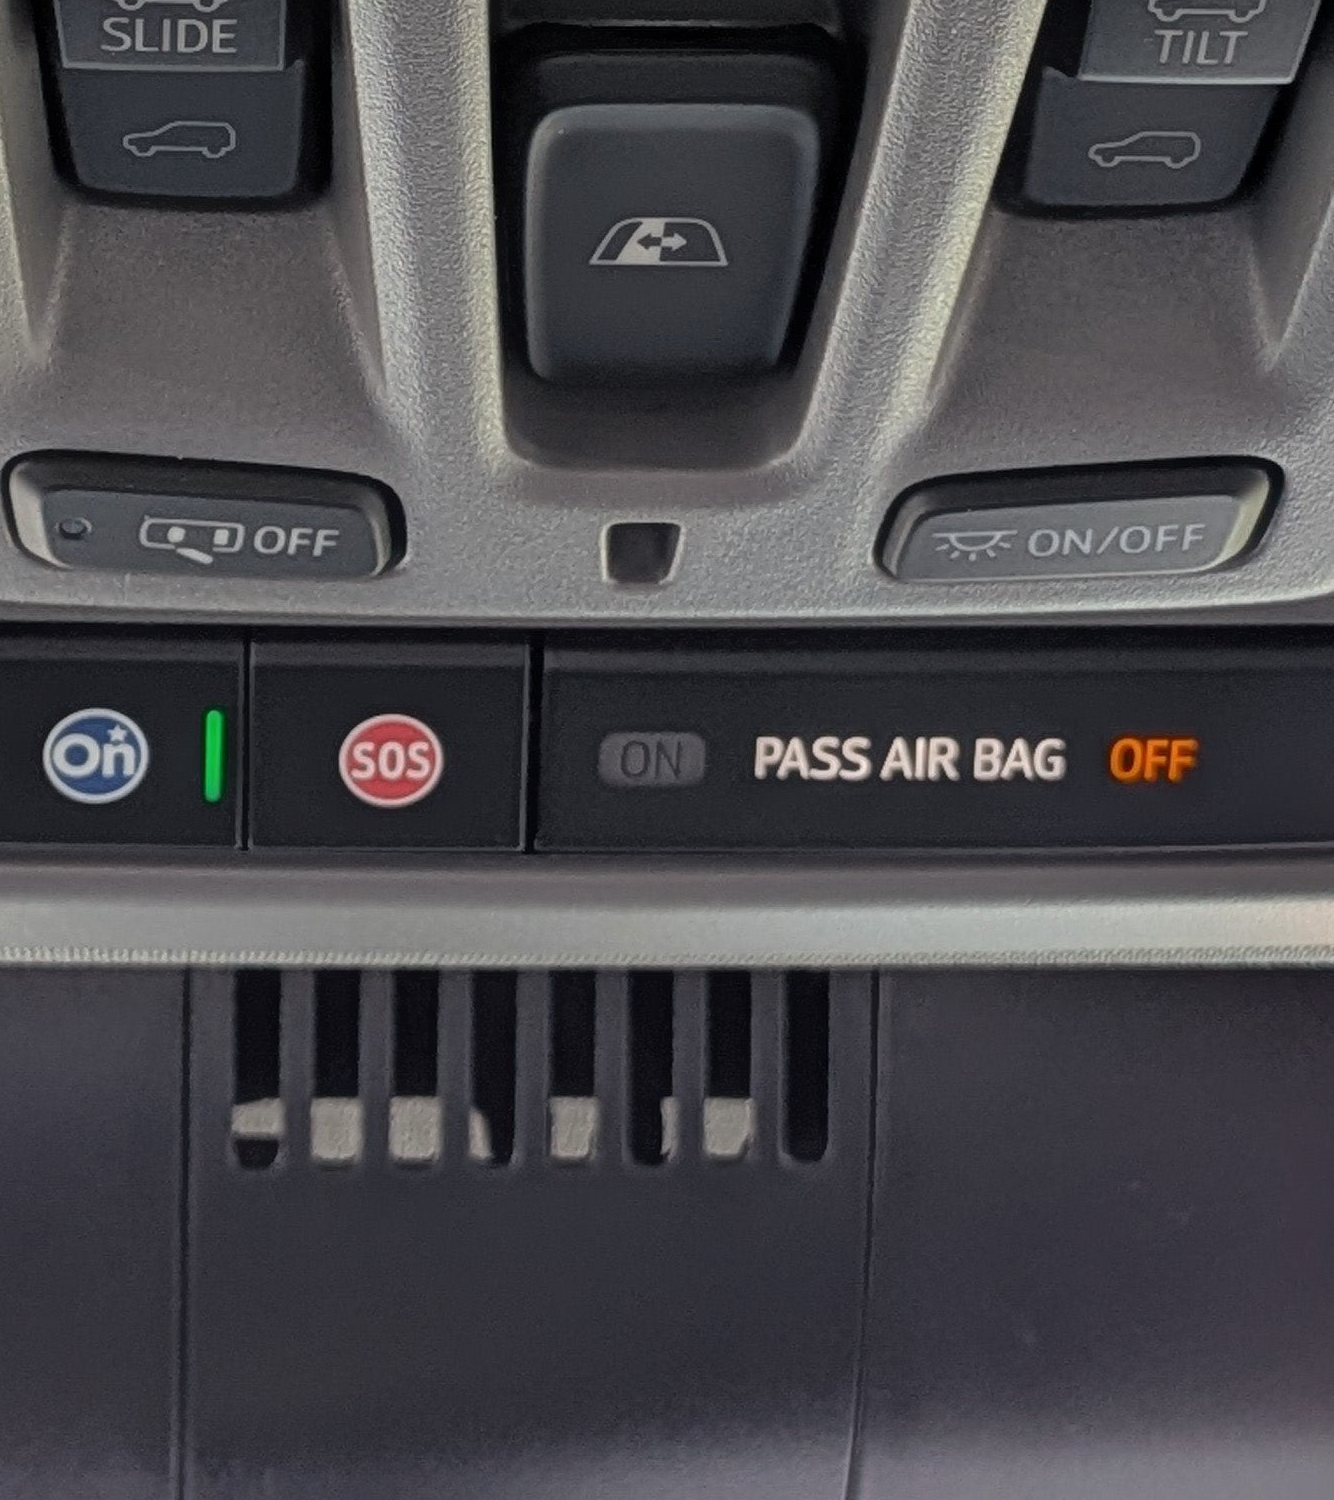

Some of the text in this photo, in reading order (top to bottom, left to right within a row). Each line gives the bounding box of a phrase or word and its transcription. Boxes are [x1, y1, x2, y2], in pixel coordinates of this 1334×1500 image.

[101, 18, 238, 54] SLIDE
[1155, 31, 1248, 65] TILT
[254, 526, 340, 557] OFF
[1028, 524, 1207, 557] ON/OFF
[53, 733, 138, 777] On
[351, 741, 431, 782] SOS
[621, 736, 1199, 782] ON PASS AIR BAG OFF
